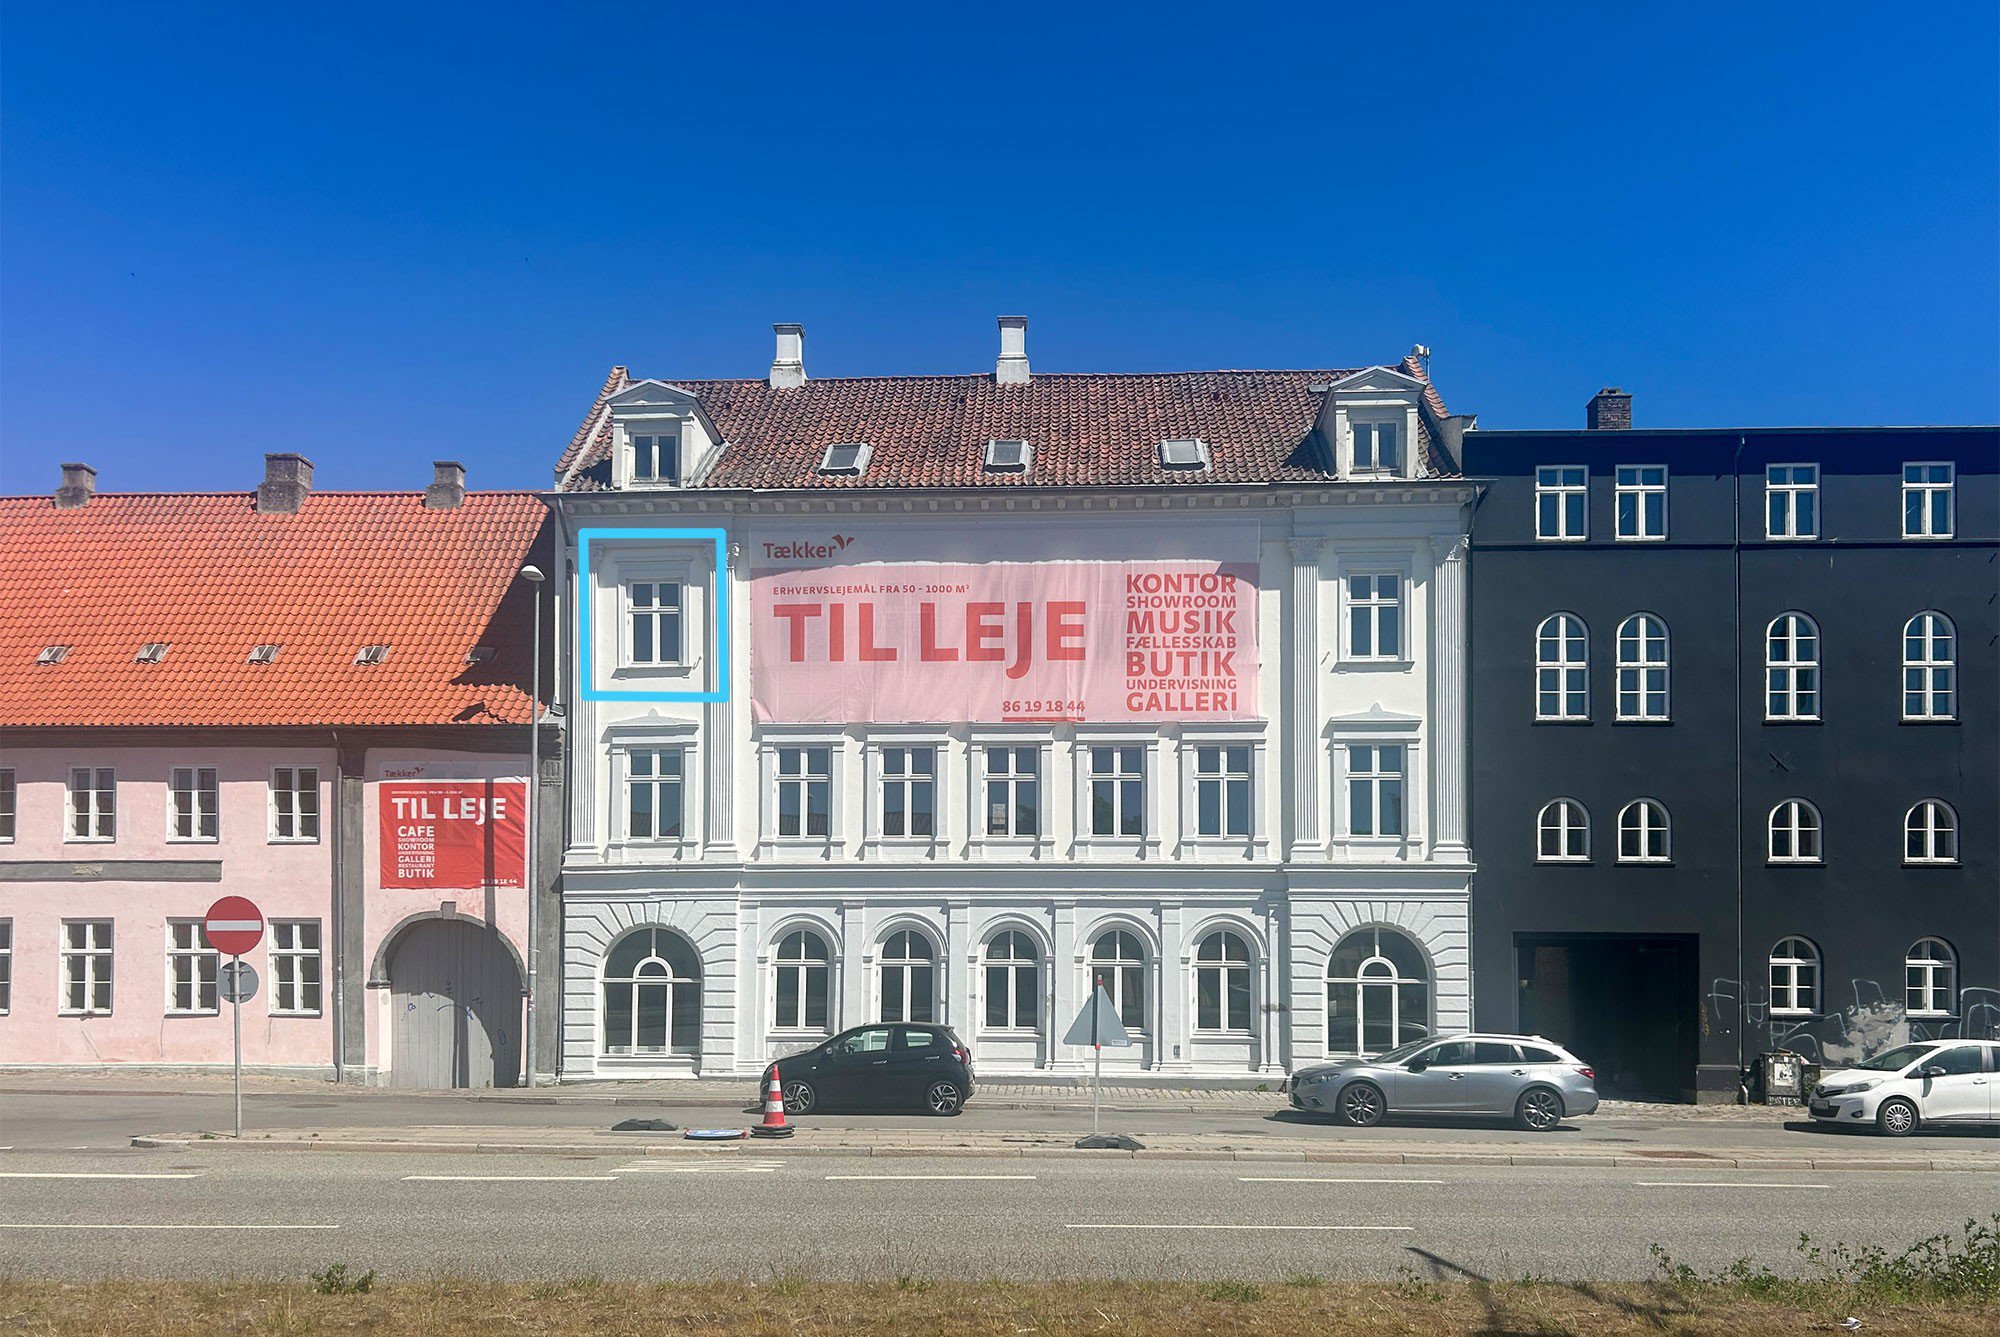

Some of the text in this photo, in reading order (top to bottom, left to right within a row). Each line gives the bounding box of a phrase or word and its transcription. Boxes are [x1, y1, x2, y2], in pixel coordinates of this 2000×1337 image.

[762, 541, 837, 559] Tækker
[773, 583, 877, 596] ERHVERVSLEJEMÅL
[880, 585, 900, 593] FRA
[902, 585, 916, 593] 50
[925, 585, 953, 593] 1000
[1126, 573, 1237, 594] KONTOR
[1126, 595, 1237, 609] SHOWROOM
[1126, 610, 1237, 634] MUSIK
[773, 601, 1087, 680] TIL LEJE
[1126, 636, 1237, 649] FÆLLESSKAB
[1126, 651, 1237, 677] BUTIK
[1126, 679, 1237, 690] UNDERVISNING
[1002, 700, 1086, 712] 86 19 18 44
[1126, 692, 1237, 712] GALLERI
[391, 797, 507, 826] TIL LEJE
[397, 825, 435, 837] CAFE
[397, 855, 435, 863] GALLERI
[397, 868, 435, 878] BUTIK
